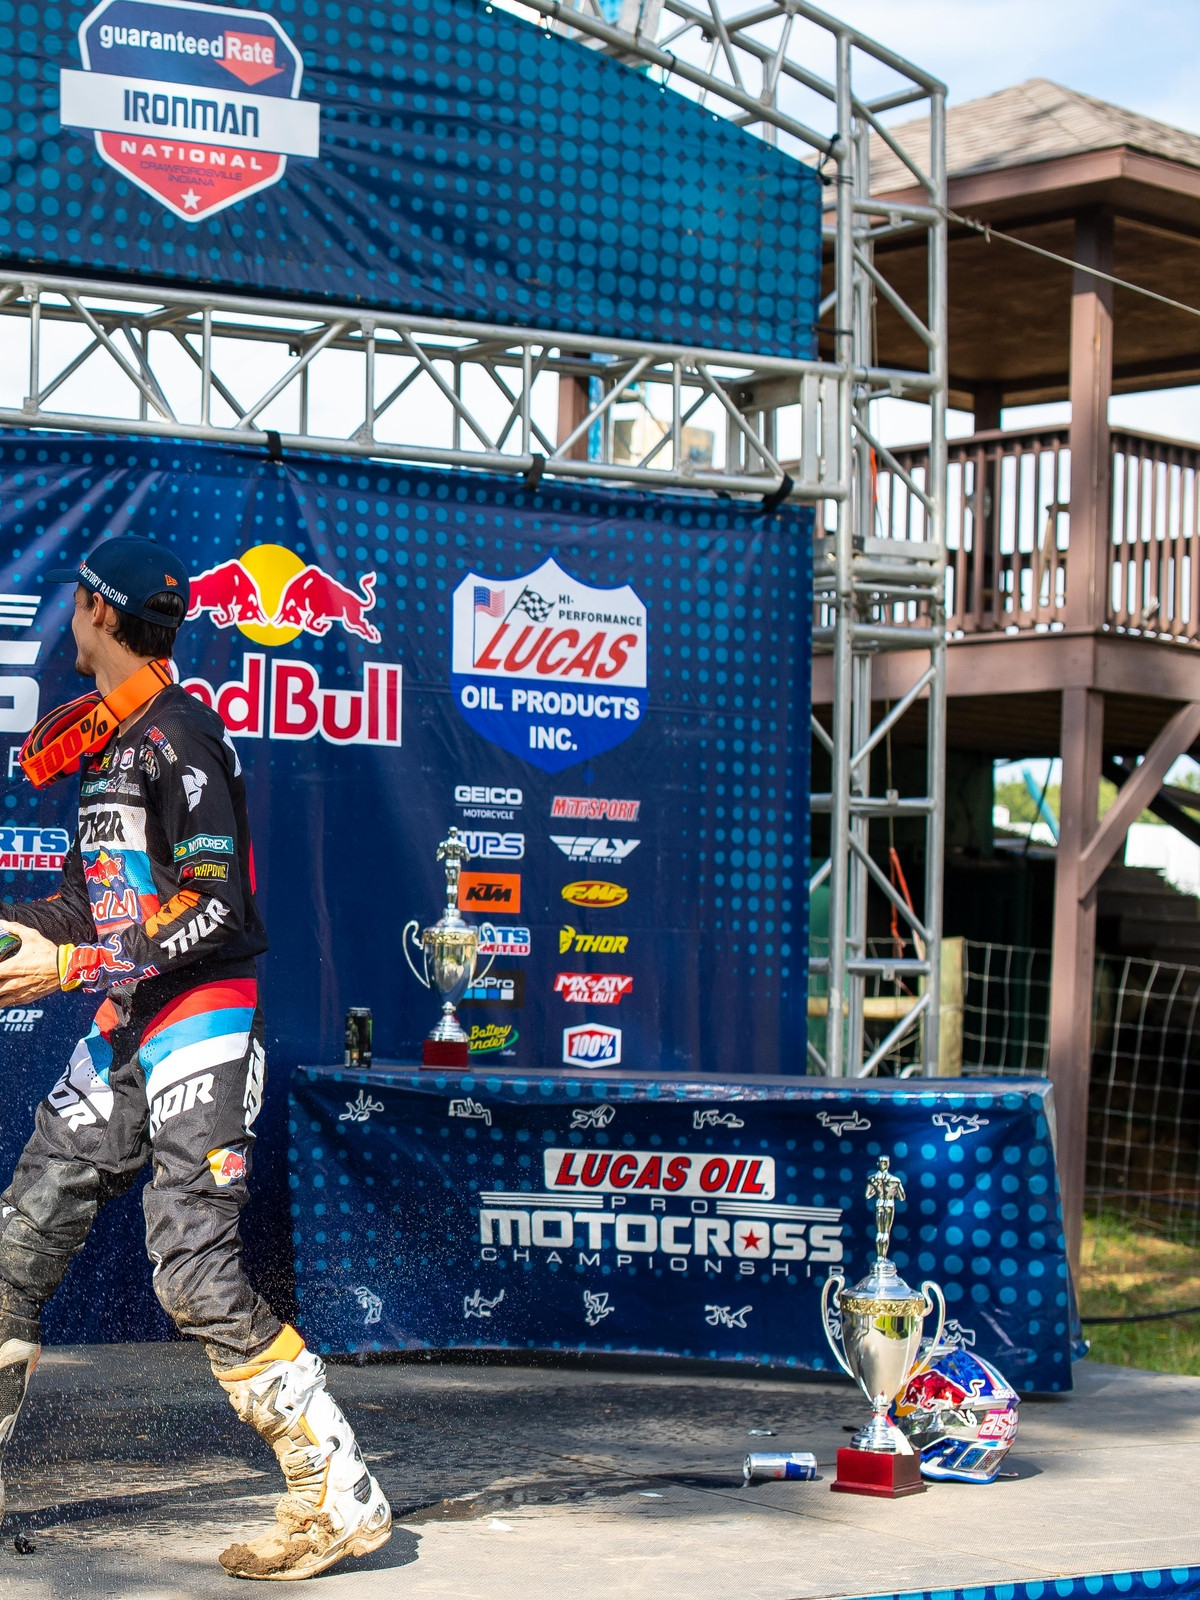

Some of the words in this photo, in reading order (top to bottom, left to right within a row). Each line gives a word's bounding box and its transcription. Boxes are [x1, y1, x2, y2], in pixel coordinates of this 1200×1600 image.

[123, 88, 259, 138] IRONMAN
[120, 140, 263, 171] NATIONAL
[139, 160, 243, 182] CRAWFORDSVILLE
[167, 173, 216, 188] INDIANA
[79, 564, 102, 588] FACTORY
[99, 582, 128, 606] RACING
[558, 593, 575, 605] HI-
[558, 610, 643, 628] PERFORMANCE
[473, 623, 638, 680] LUCAS
[271, 660, 401, 745] Bull
[461, 685, 504, 711] OIL
[511, 689, 640, 721] PRODUCTS
[28, 709, 109, 781] 100%
[529, 725, 578, 751] INC.
[455, 785, 523, 806] GEICO
[463, 809, 514, 820] MOTORCYCLE
[188, 837, 229, 852] MOTOREX
[549, 835, 641, 858] FLY
[568, 855, 622, 864] RACING
[466, 883, 512, 902] KTM
[563, 884, 629, 901] FMF
[160, 898, 230, 960] THOR
[575, 935, 629, 953] THOR
[471, 976, 515, 989] oPro
[555, 975, 593, 991] MX
[593, 976, 634, 992] ATV
[565, 991, 591, 1003] ALL
[592, 992, 618, 1003] OUT
[3, 1022, 34, 1032] TIRES
[470, 1024, 512, 1041] Battery
[570, 1034, 614, 1058] 100%
[555, 1152, 692, 1192] LUCAS
[699, 1157, 766, 1194] OIL
[611, 1195, 708, 1214] PRO
[479, 1209, 843, 1263] MOTOCROSS
[481, 1247, 845, 1278] CHAMPIONSHIP
